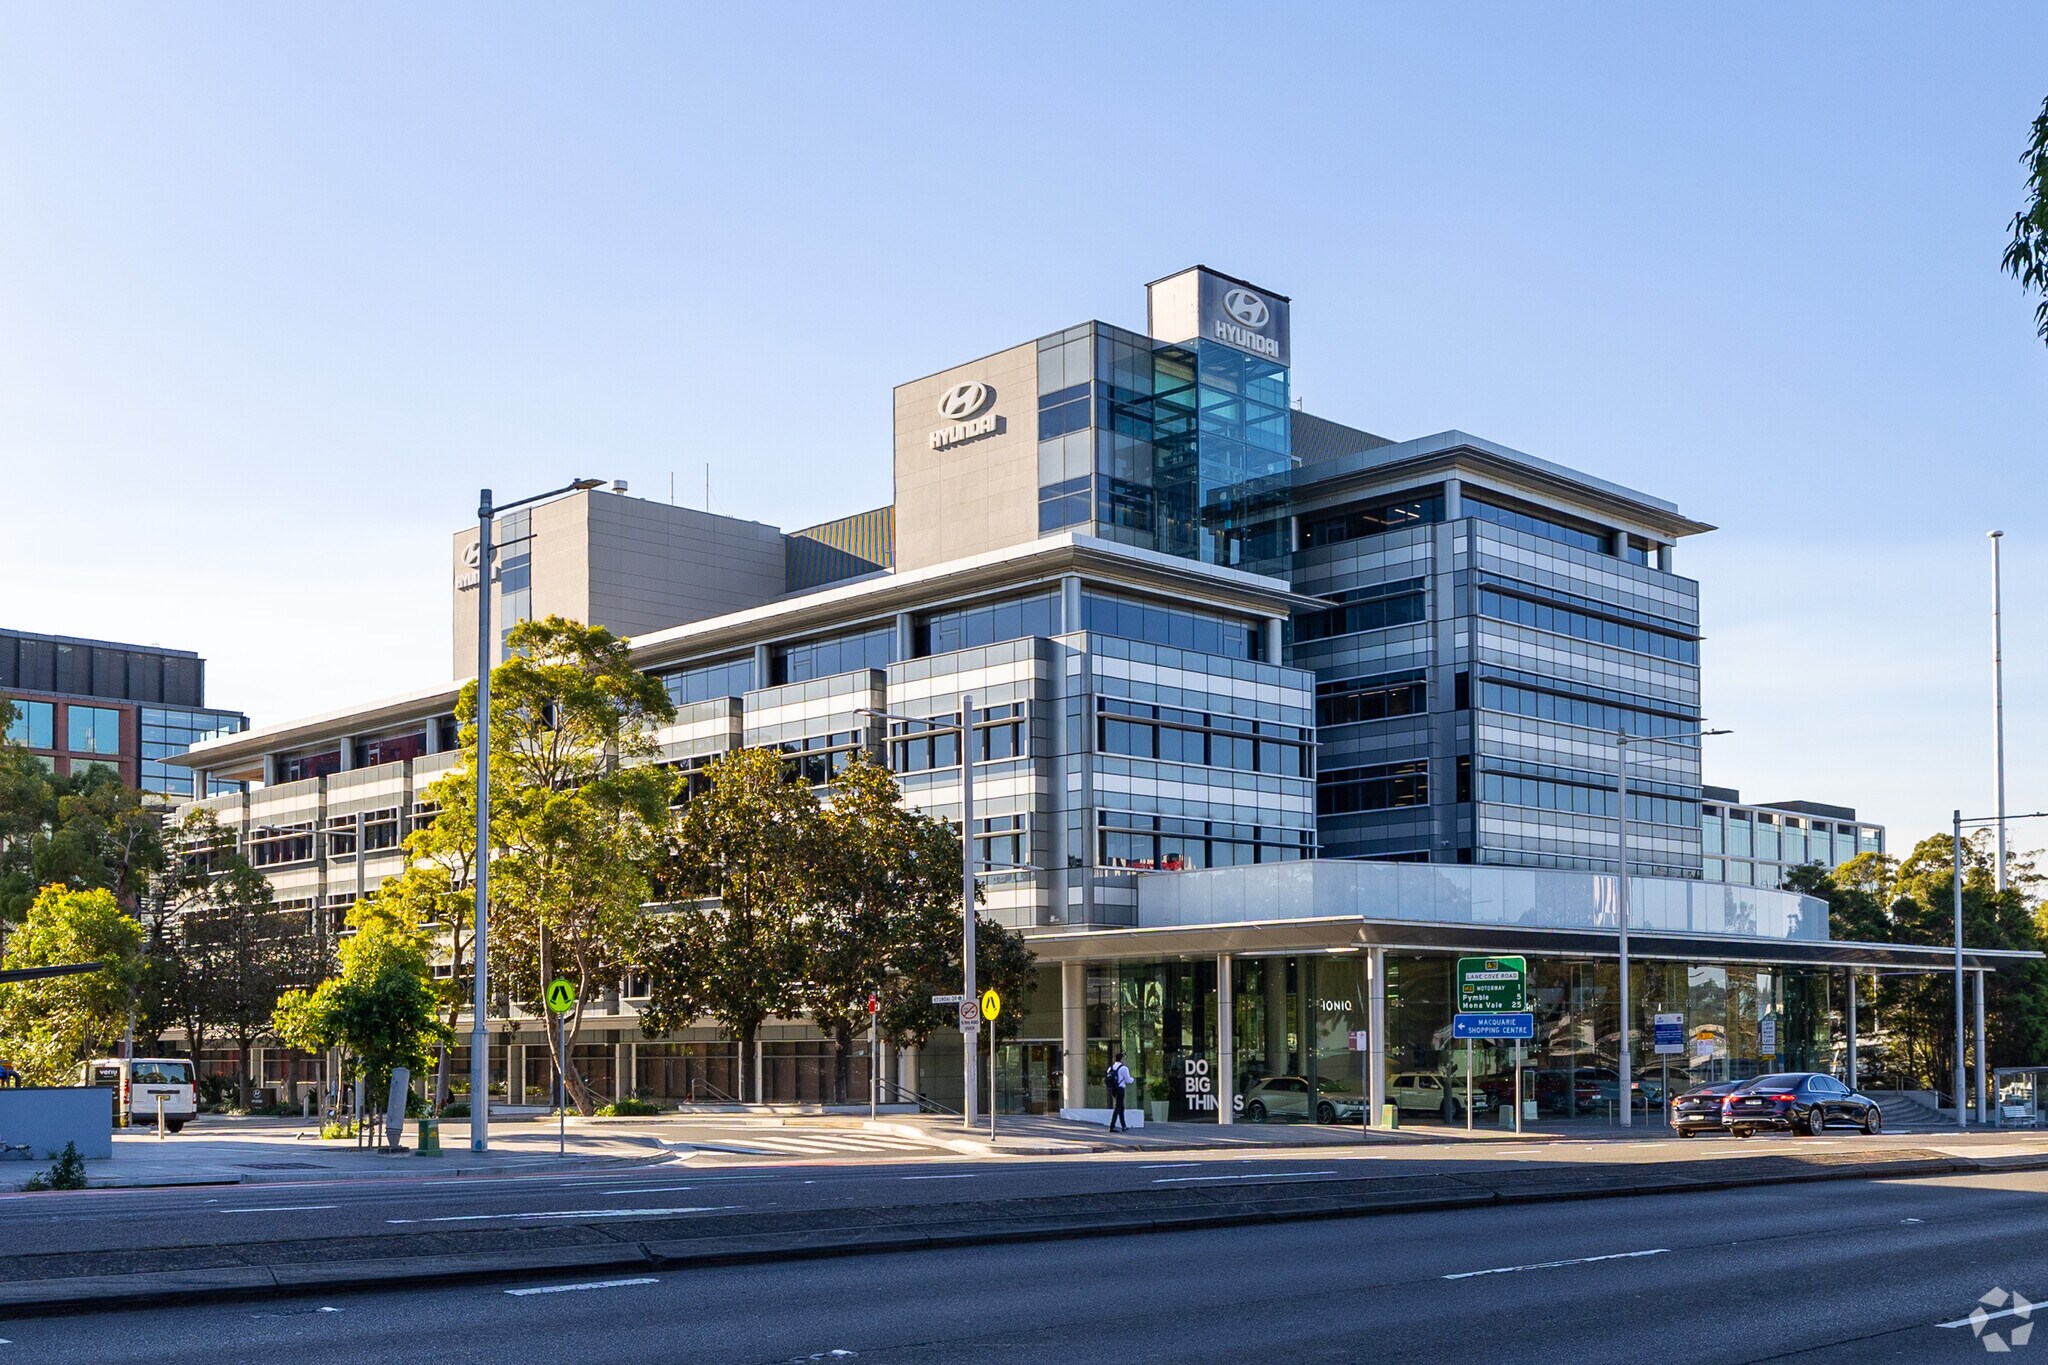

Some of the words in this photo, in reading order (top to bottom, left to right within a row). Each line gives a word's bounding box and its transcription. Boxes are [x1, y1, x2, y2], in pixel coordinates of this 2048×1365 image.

[1214, 320, 1279, 358] HYUNDAI
[929, 413, 996, 450] HYUNDAI
[456, 566, 496, 588] HYUNI
[1322, 1000, 1352, 1011] IONIQ
[1462, 994, 1489, 1002] Pymble
[1511, 1001, 1522, 1009] 25
[1478, 1018, 1516, 1026] MACQUARIE
[1468, 1026, 1500, 1034] SHOPPING
[1502, 1026, 1527, 1034] CENTRE
[1185, 1059, 1208, 1075] DO
[1185, 1077, 1210, 1092] BIG
[1185, 1094, 1244, 1111] THINS
